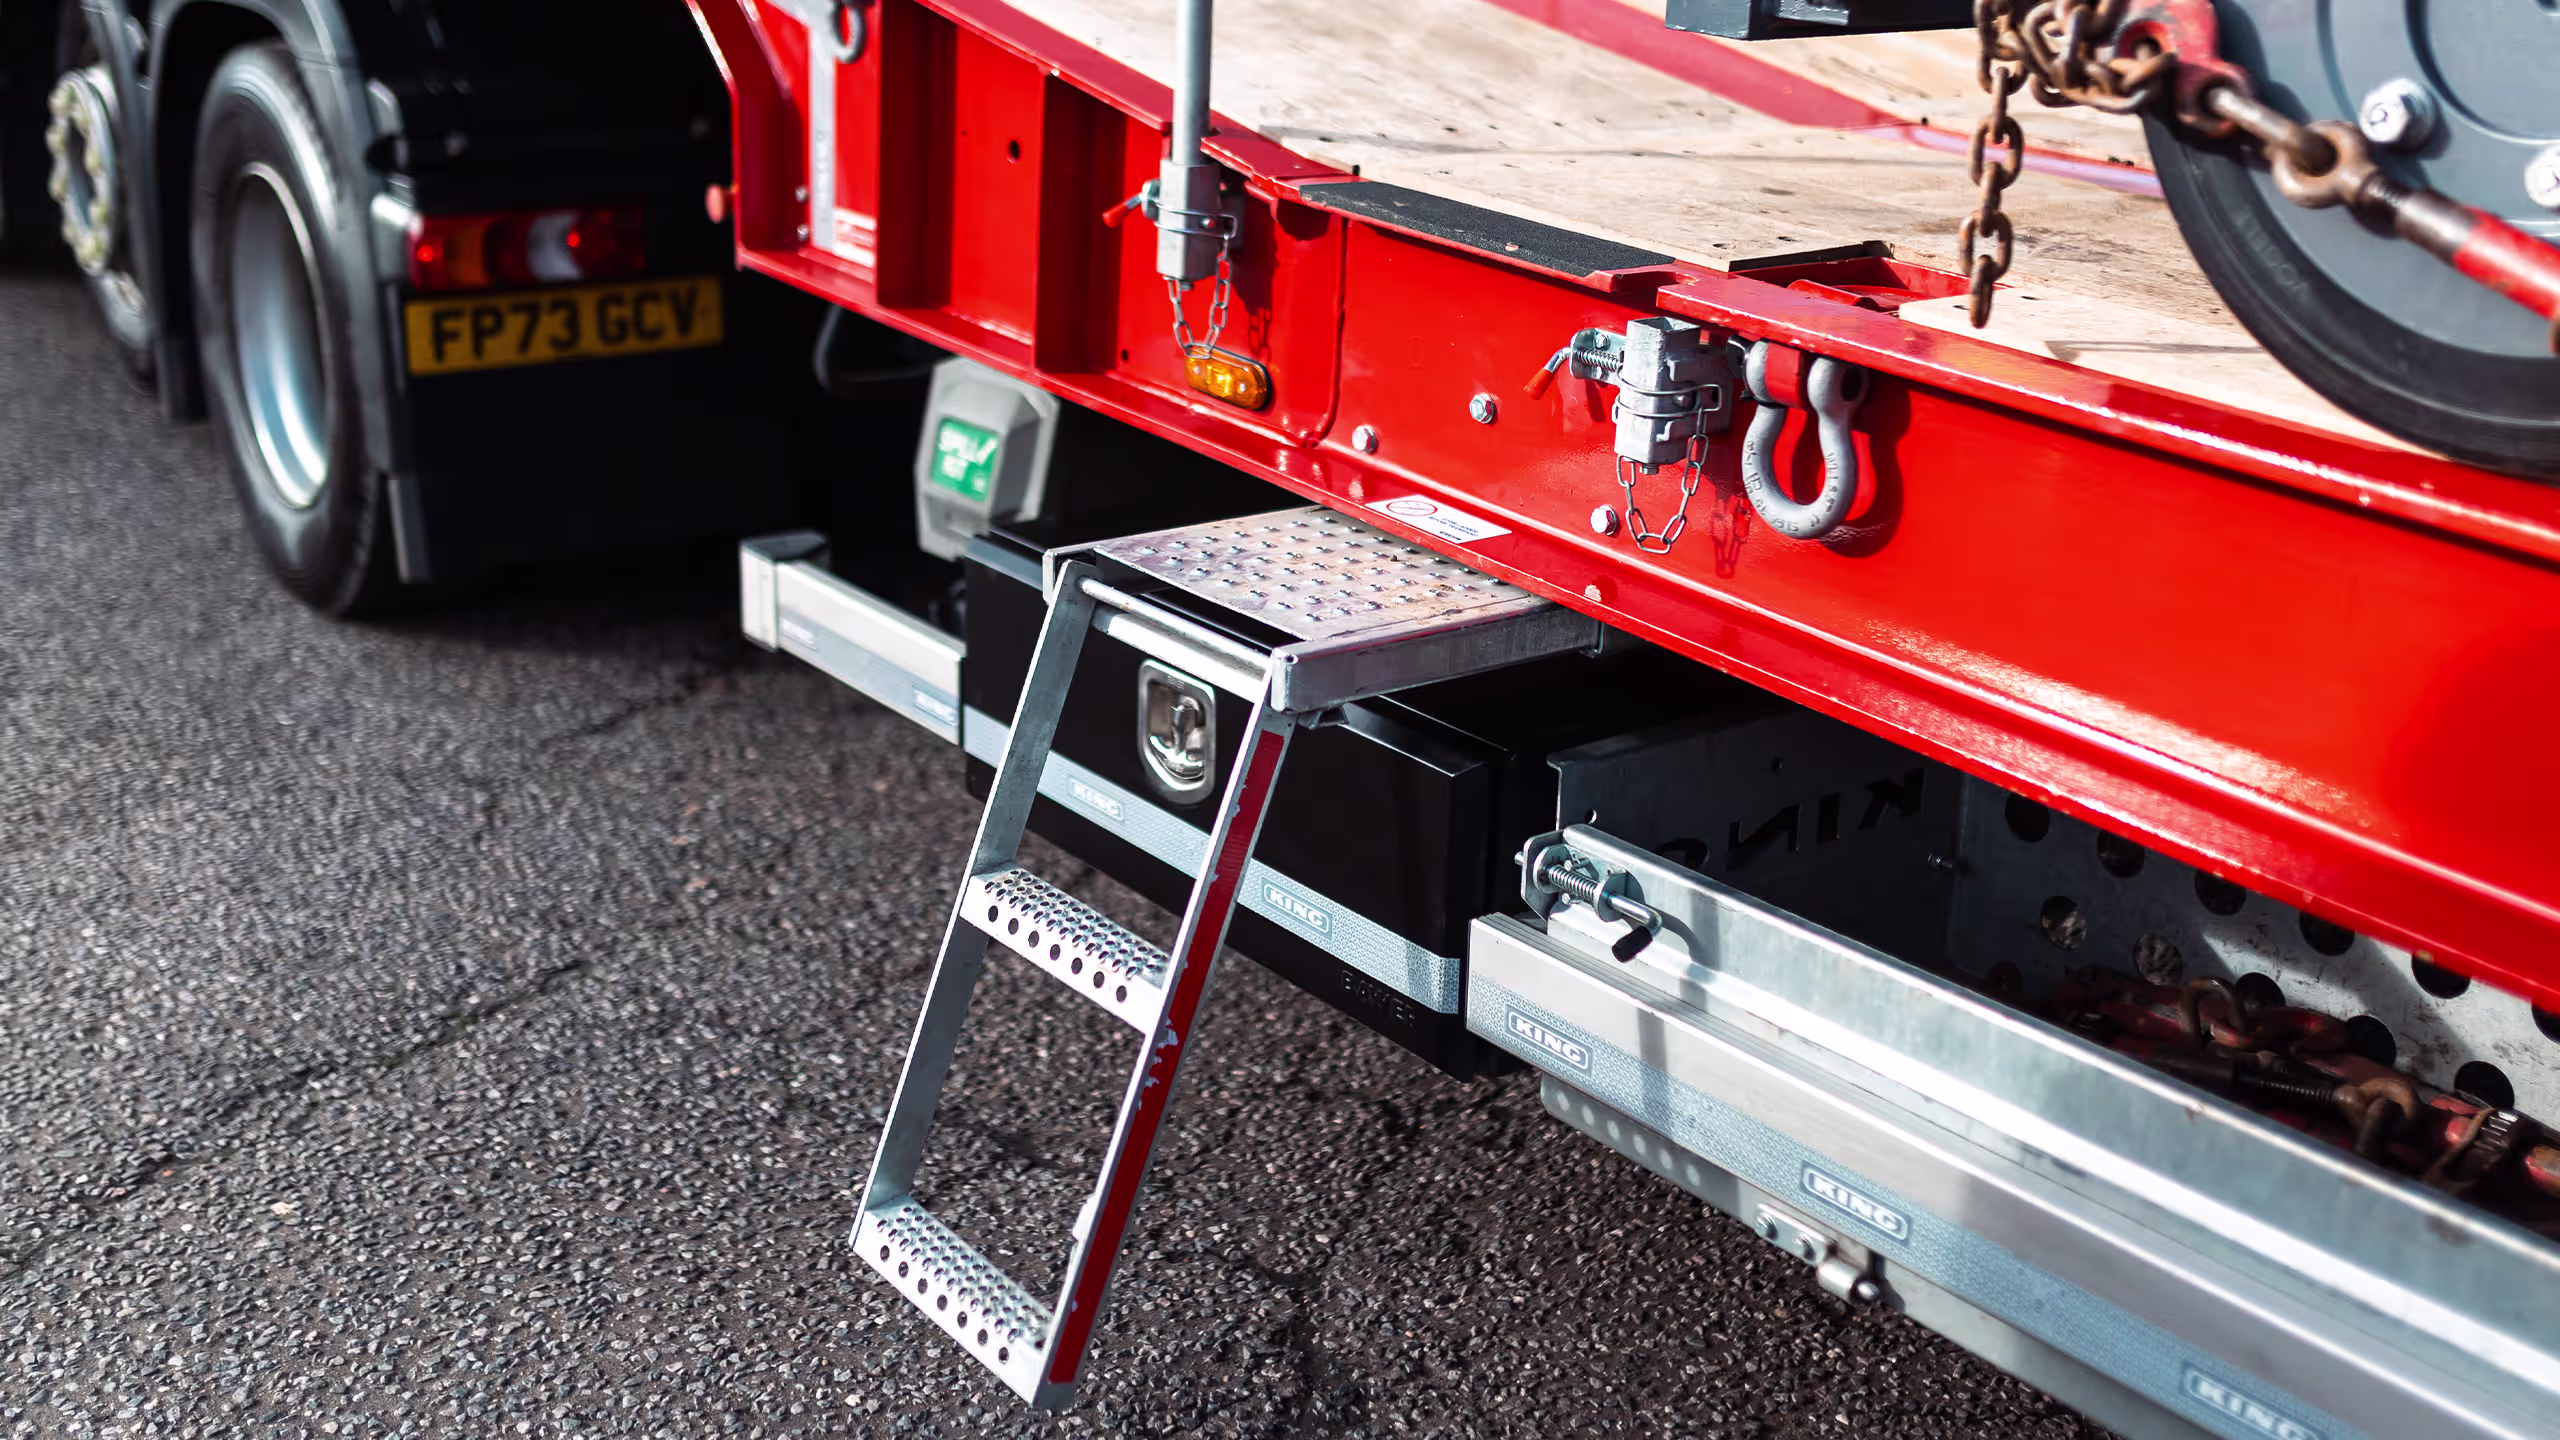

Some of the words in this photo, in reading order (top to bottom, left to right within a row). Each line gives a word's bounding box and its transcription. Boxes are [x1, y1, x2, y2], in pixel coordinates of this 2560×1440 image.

[430, 299, 581, 365] FP73
[597, 285, 698, 346] GCV
[1073, 783, 1120, 816] KING
[1270, 889, 1324, 927] KING
[1516, 1017, 1582, 1063] KING
[1812, 1174, 1899, 1232] KING
[2199, 1379, 2307, 1440] KING
